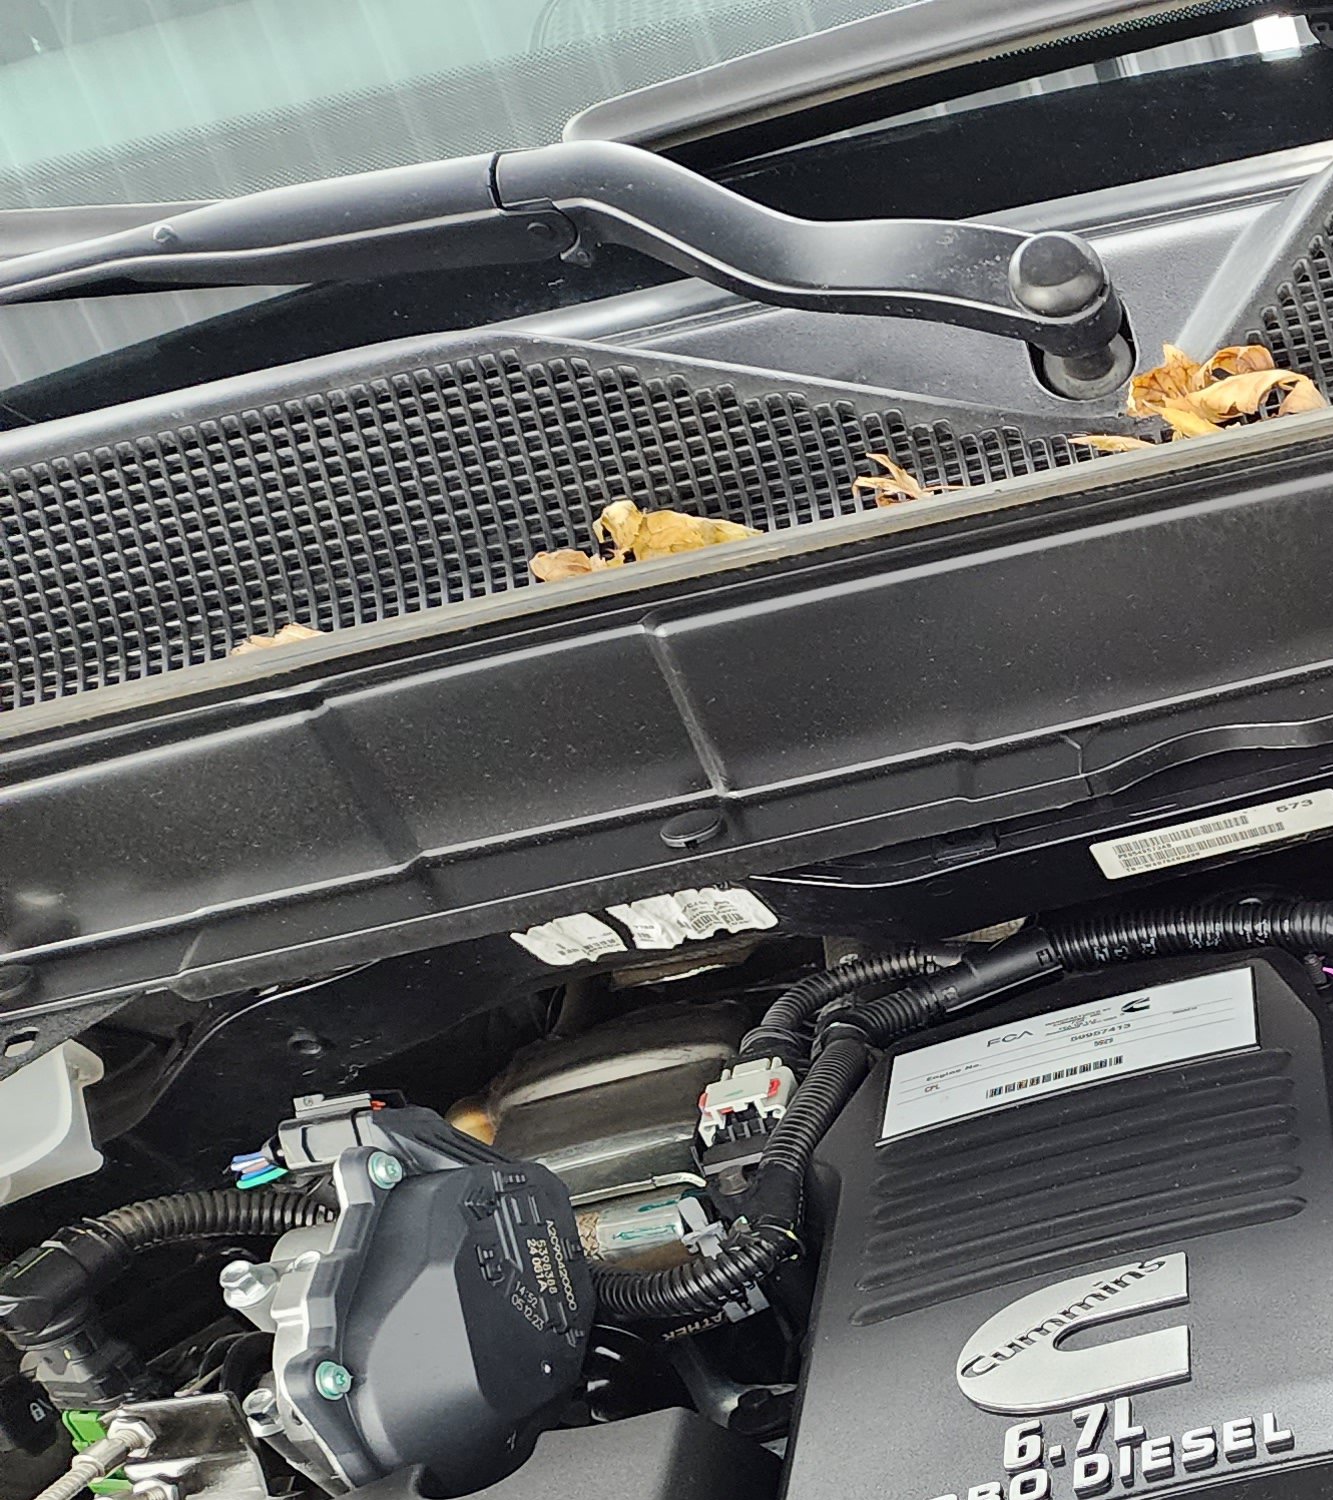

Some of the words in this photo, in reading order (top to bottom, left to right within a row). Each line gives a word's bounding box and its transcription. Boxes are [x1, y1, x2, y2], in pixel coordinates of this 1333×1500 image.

[1275, 799, 1314, 814] 573
[986, 1030, 1034, 1048] FCA
[926, 1067, 962, 1082] Engine
[526, 1238, 538, 1256] 24
[545, 1219, 578, 1312] A2C90420000
[959, 1257, 1167, 1379] Cummins
[1003, 1396, 1146, 1476] 6.7L
[1072, 1411, 1296, 1498] DIESEL
